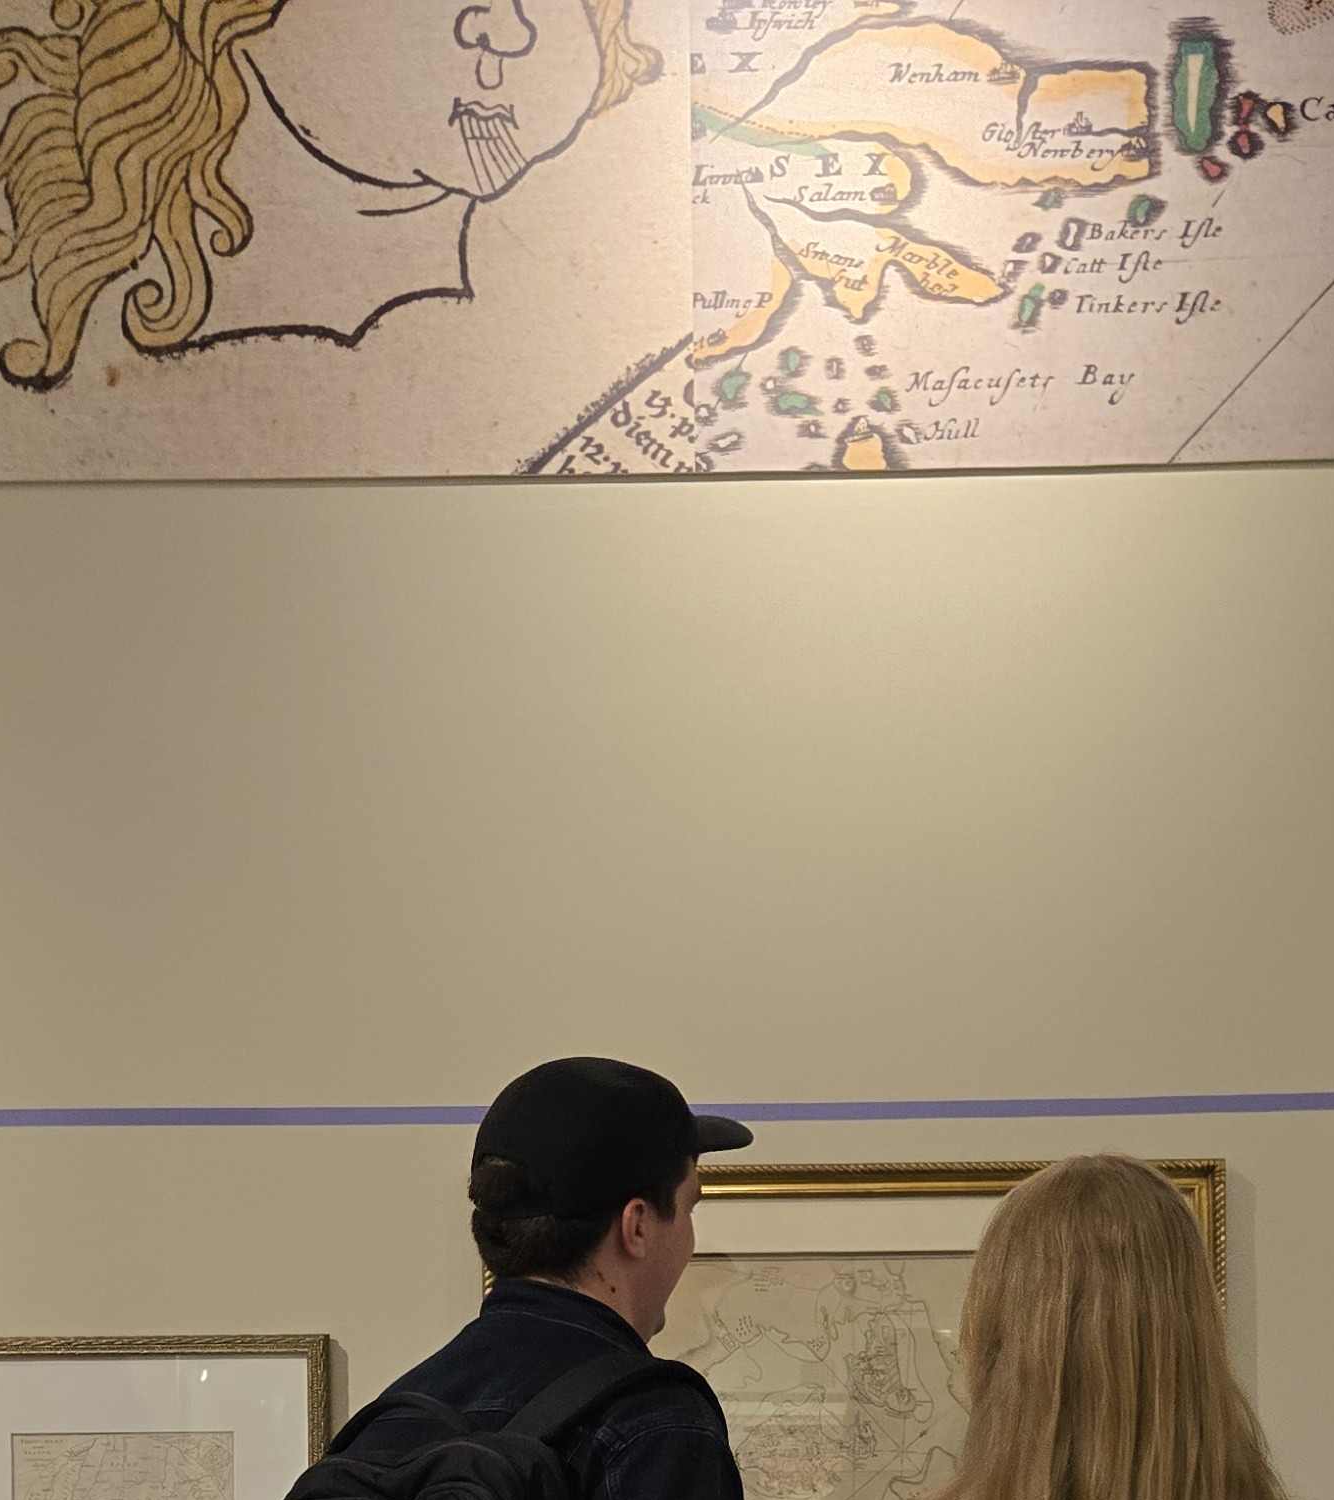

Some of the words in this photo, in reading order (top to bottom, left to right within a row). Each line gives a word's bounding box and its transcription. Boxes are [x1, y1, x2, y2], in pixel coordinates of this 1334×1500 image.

[887, 61, 982, 86] Wenham
[1084, 218, 1168, 243] Bakers
[1076, 364, 1136, 406] Bay
[923, 418, 980, 443] Hull
